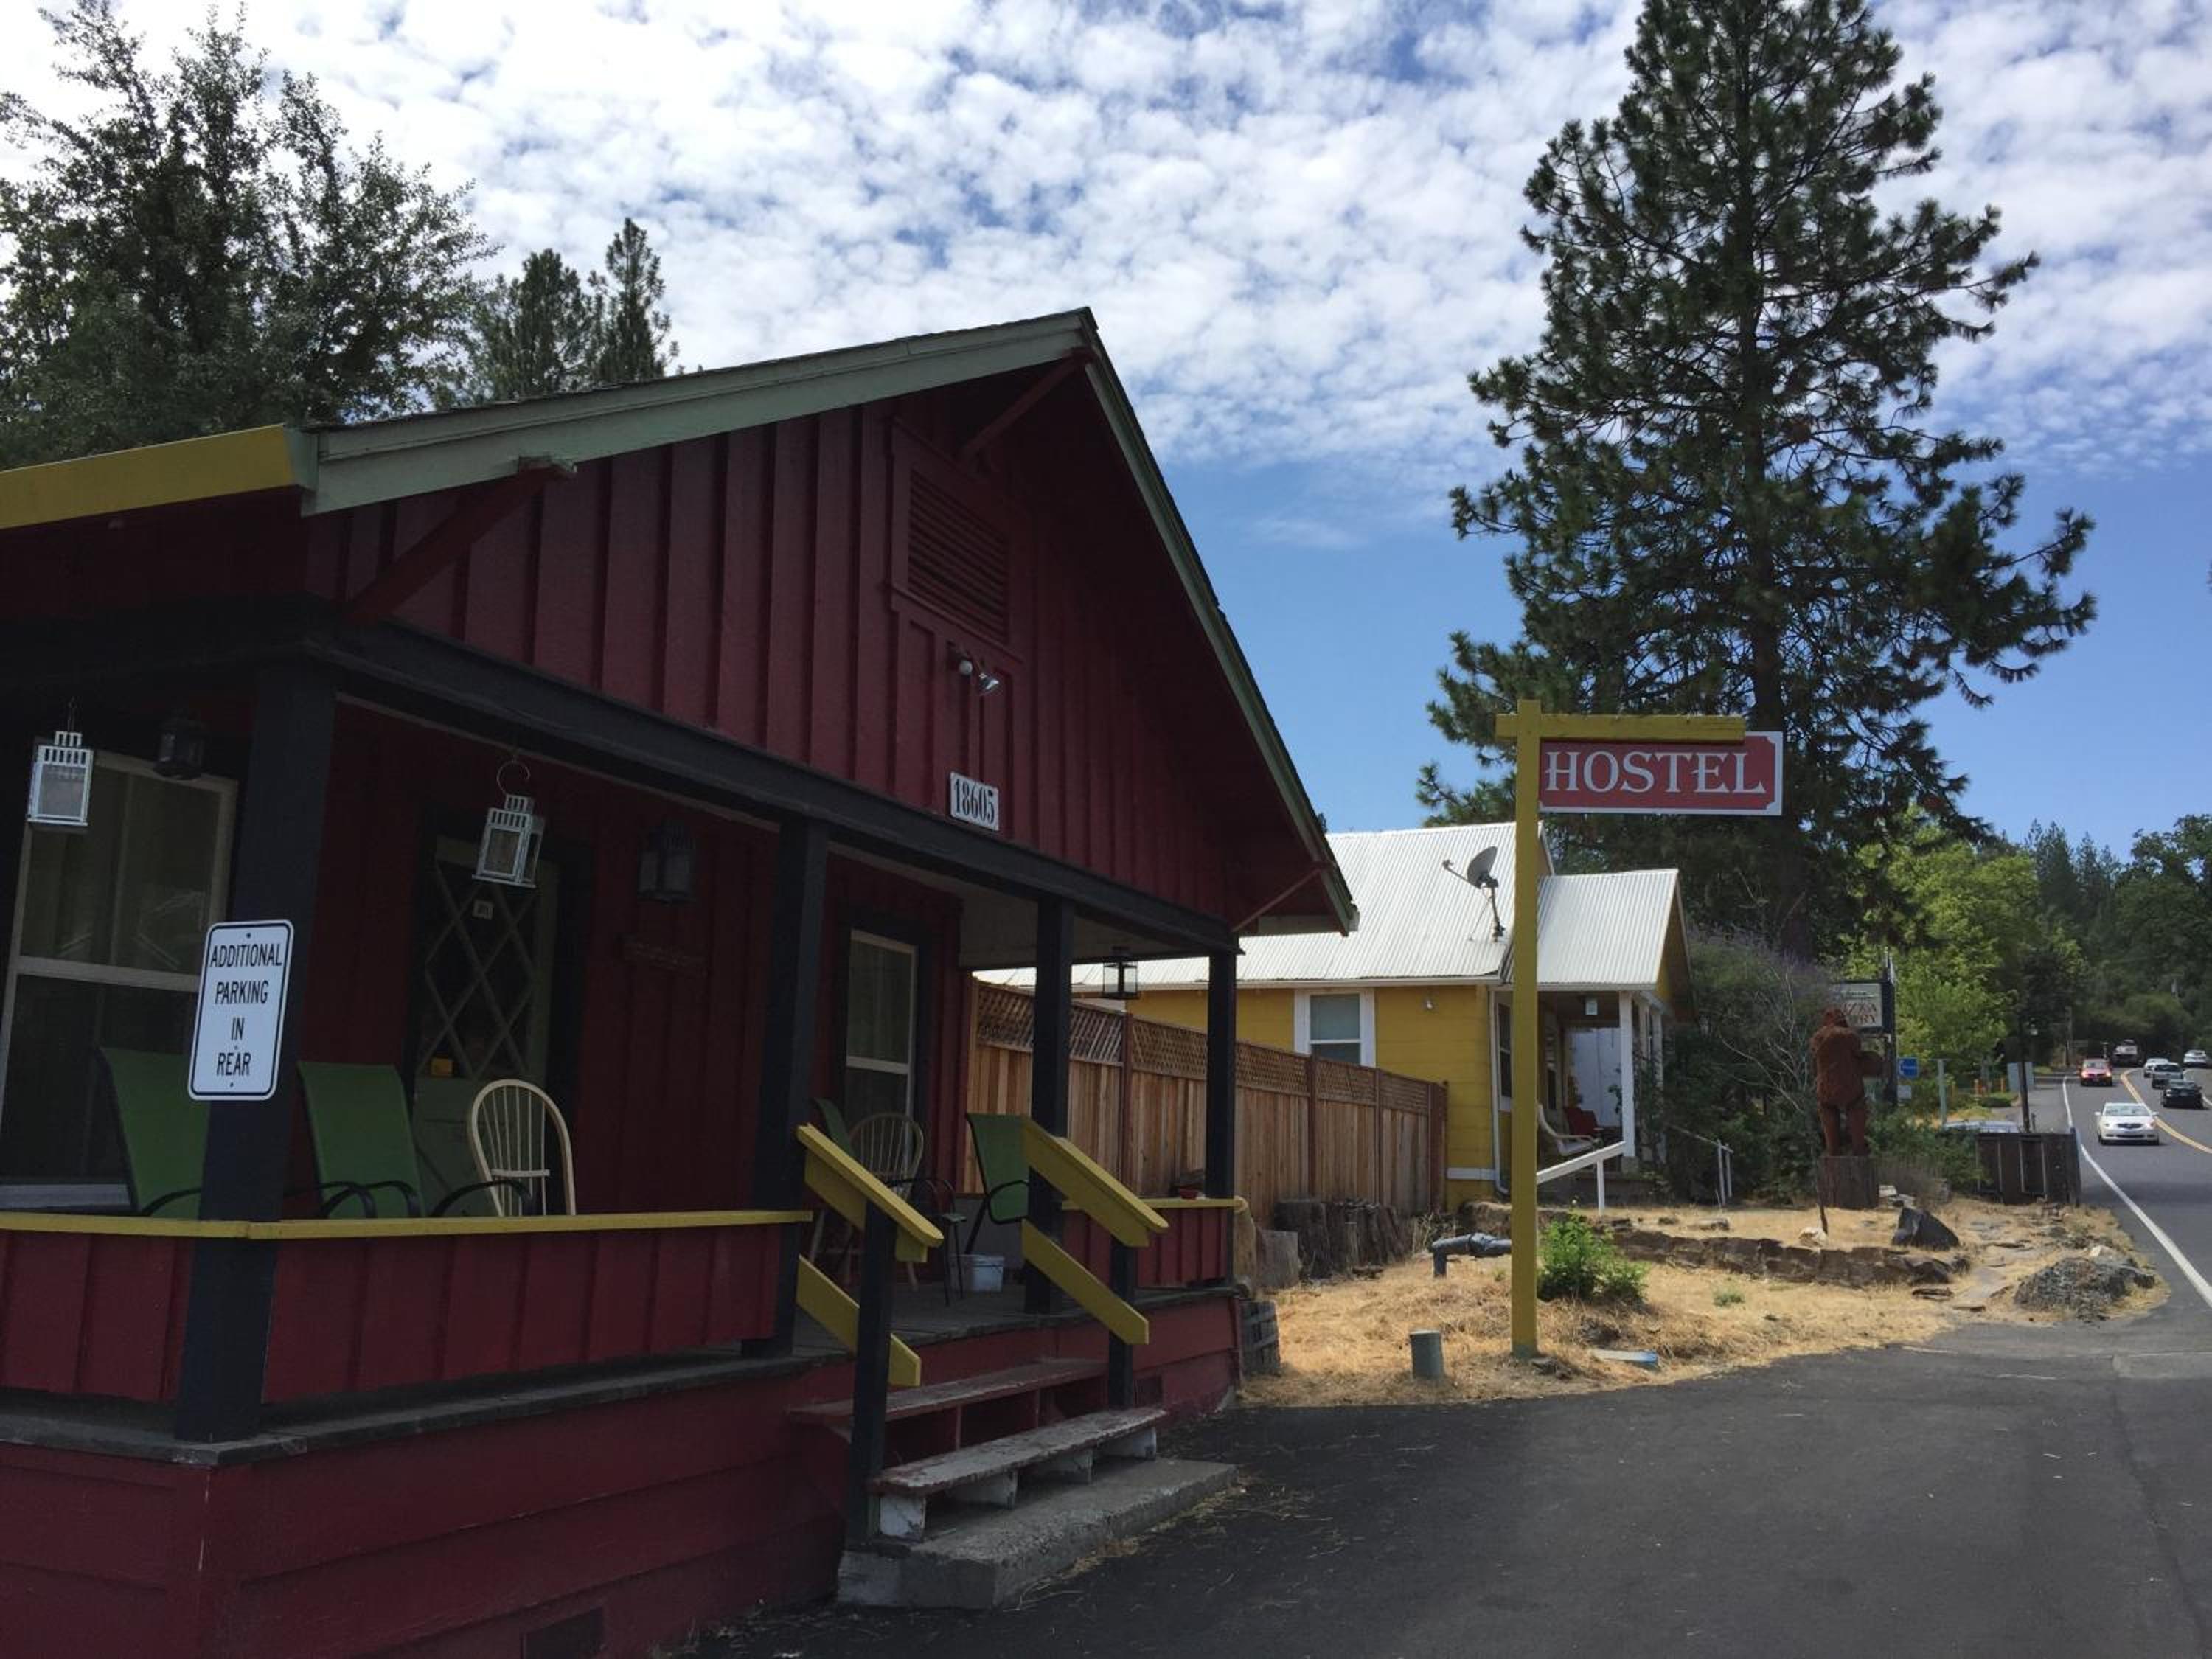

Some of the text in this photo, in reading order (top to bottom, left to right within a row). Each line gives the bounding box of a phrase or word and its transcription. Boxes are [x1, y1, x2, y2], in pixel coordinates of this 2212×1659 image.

[1545, 751, 1767, 793] HOSTEL
[954, 779, 995, 824] 18605
[209, 943, 282, 968] ADDITIONAL
[215, 980, 269, 1005] PARKING
[231, 1017, 245, 1041] IN
[216, 1051, 252, 1077] REAR
